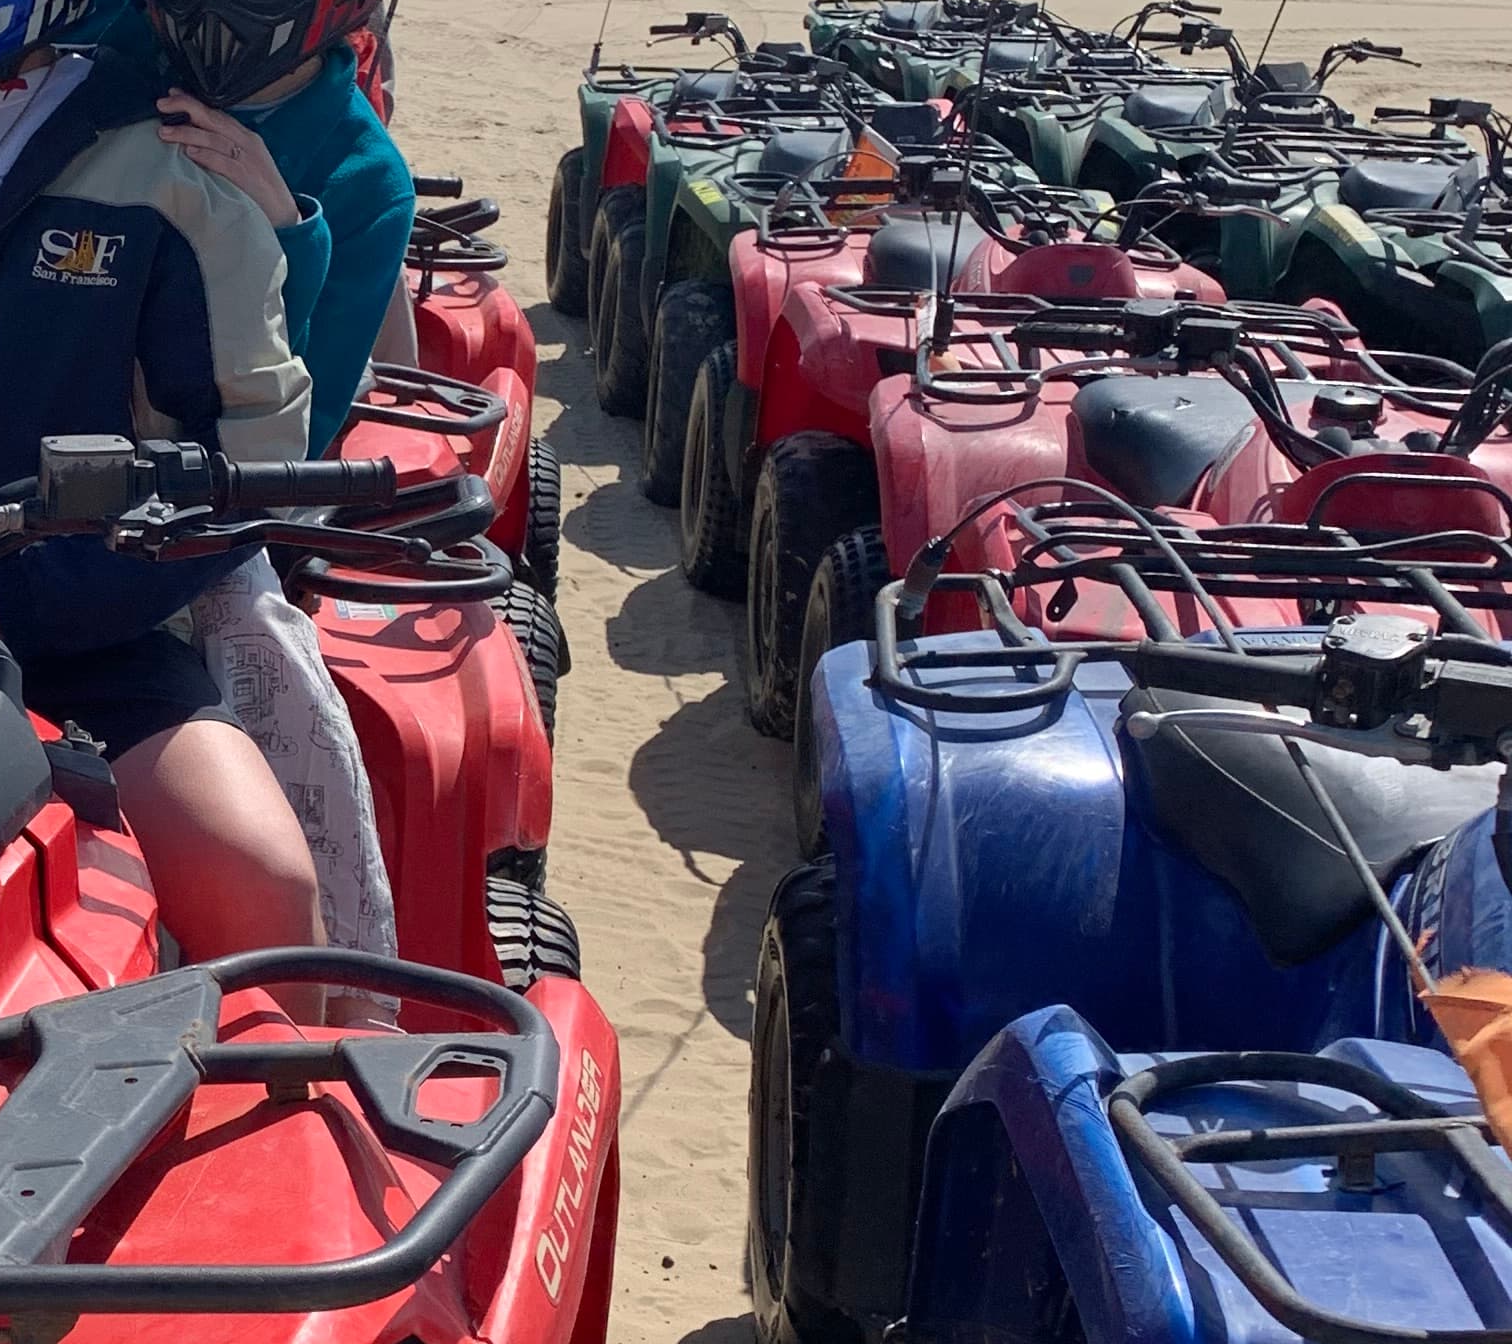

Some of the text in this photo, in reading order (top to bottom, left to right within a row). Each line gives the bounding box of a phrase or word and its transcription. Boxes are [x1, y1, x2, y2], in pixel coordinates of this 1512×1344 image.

[32, 265, 118, 287] San Francisco
[536, 1049, 602, 1298] OUTLANDER
